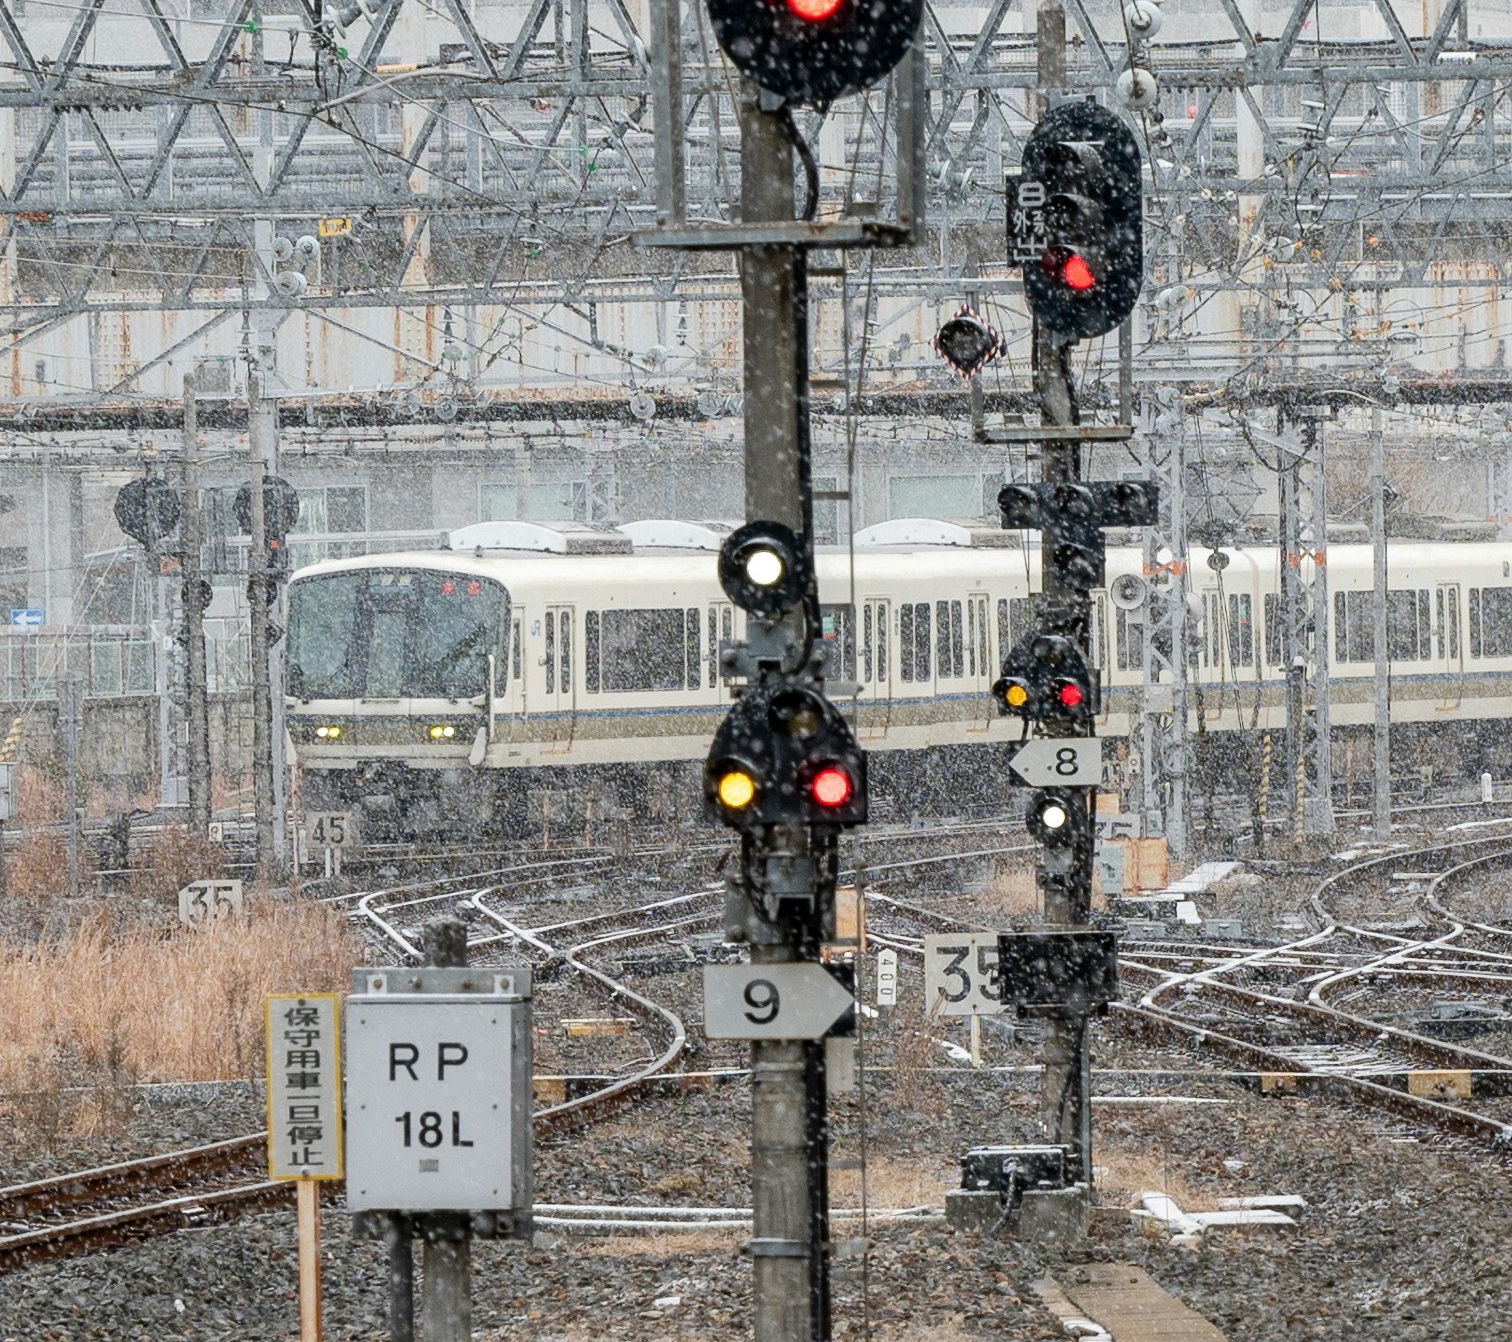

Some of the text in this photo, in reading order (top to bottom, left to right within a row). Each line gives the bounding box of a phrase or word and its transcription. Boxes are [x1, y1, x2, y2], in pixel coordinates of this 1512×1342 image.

[1055, 747, 1079, 776] 8
[312, 816, 346, 845] 45
[187, 886, 234, 926] 35
[880, 958, 894, 995] 400
[743, 977, 781, 1025] 9
[283, 1006, 324, 1167] 保守用車一旦停止
[396, 1110, 475, 1149] 18L
